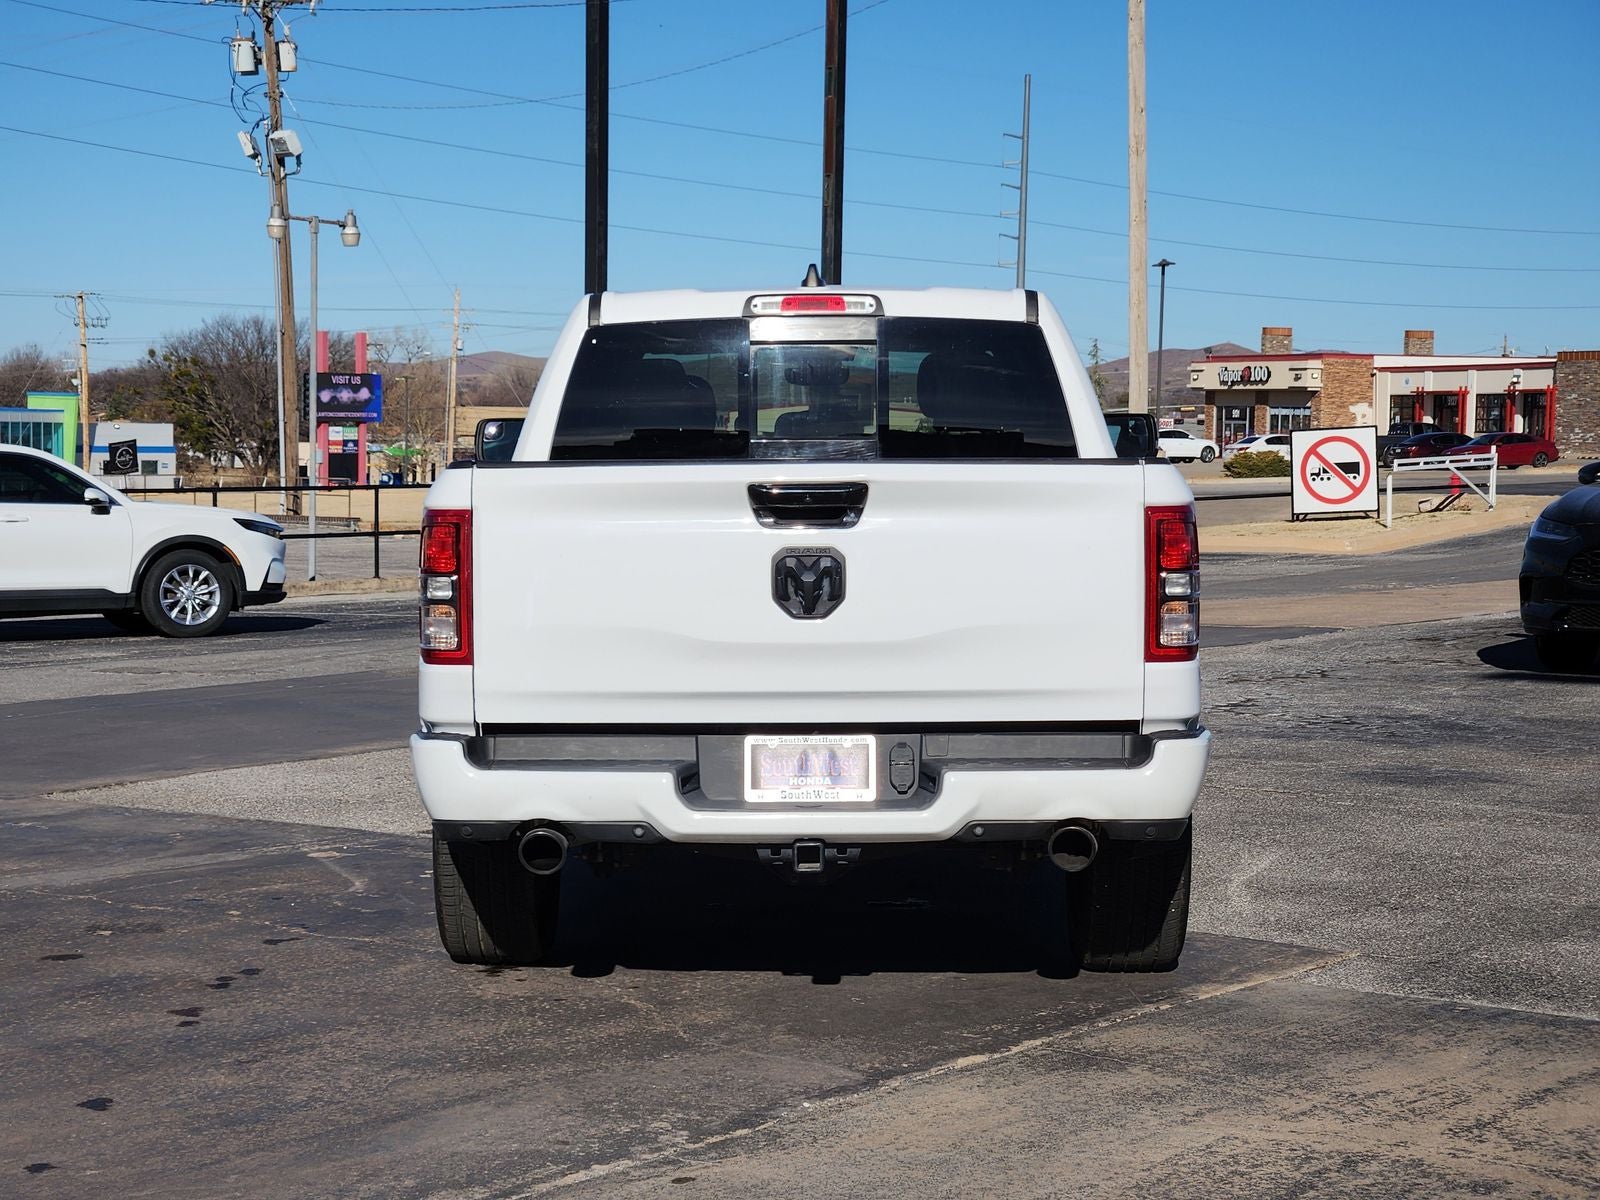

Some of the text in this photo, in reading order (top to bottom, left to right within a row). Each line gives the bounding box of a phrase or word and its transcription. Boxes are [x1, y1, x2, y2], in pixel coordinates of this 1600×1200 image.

[331, 375, 362, 385] VISIT US
[1219, 366, 1269, 386] Vapor 100
[785, 547, 831, 555] RAM
[789, 776, 832, 786] HONDA
[780, 789, 841, 800] SouthWest
